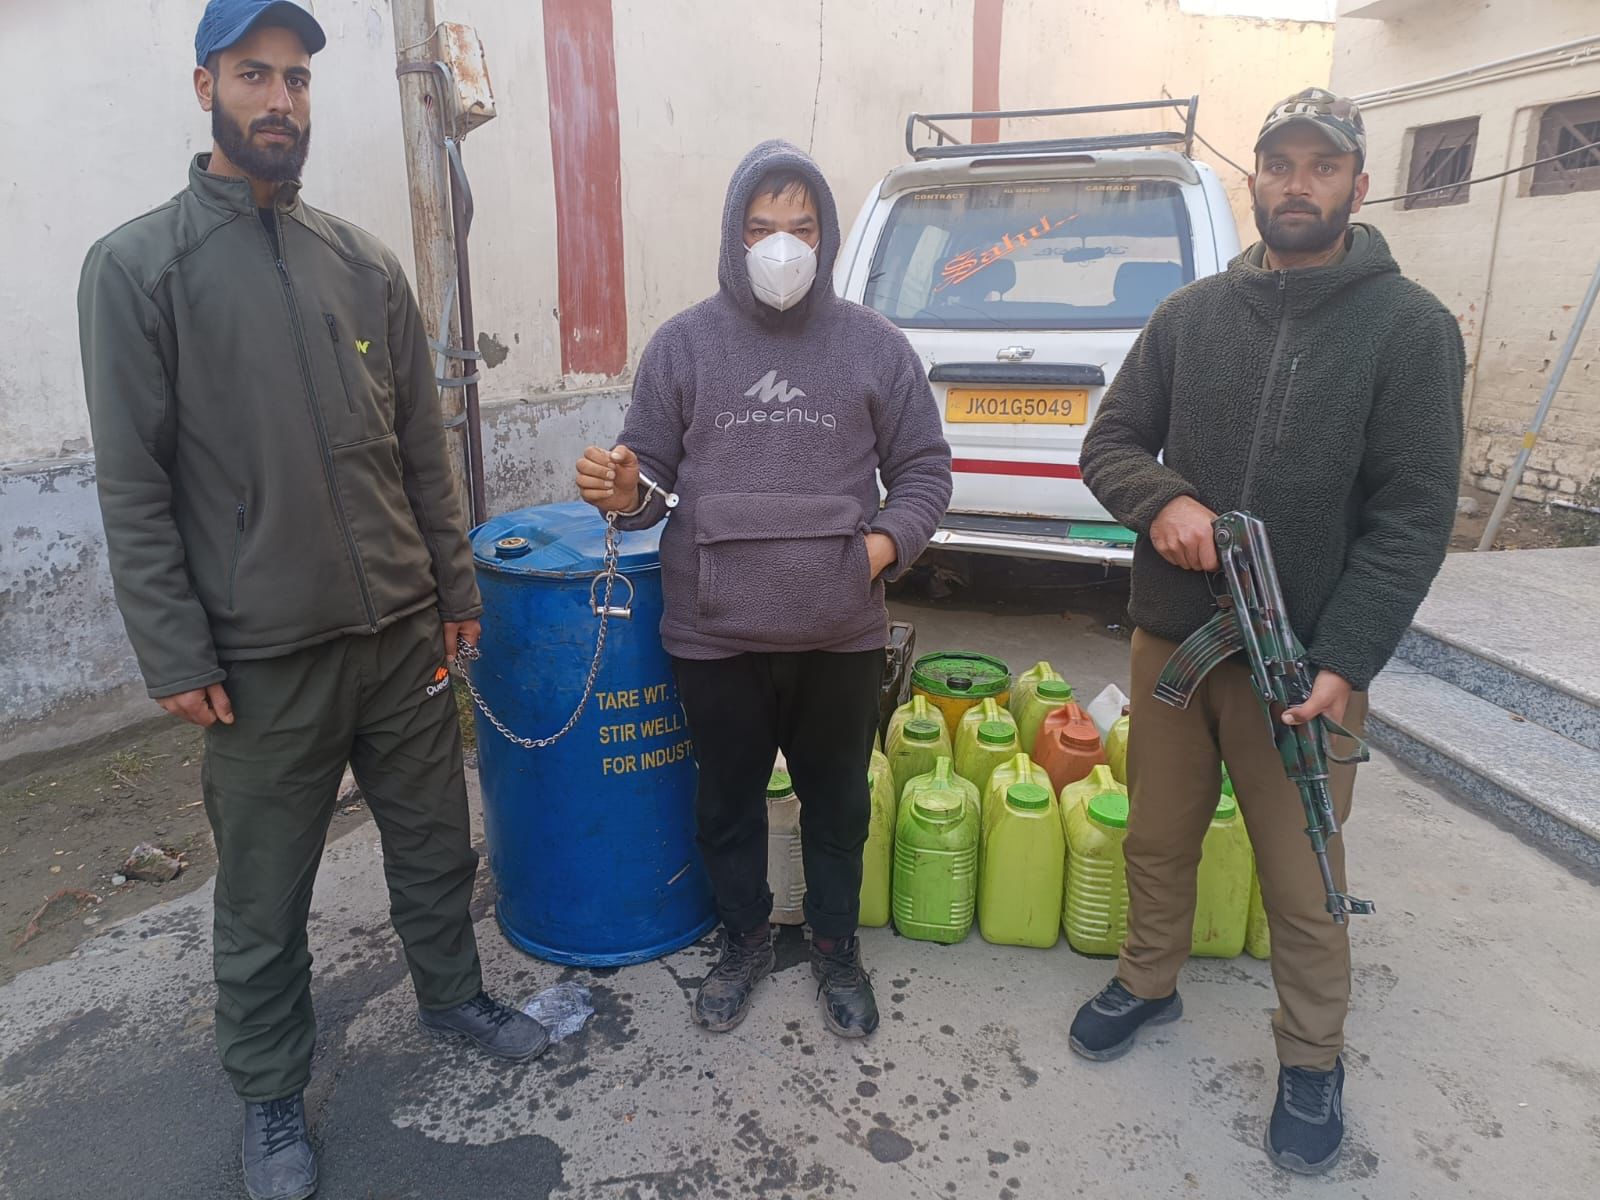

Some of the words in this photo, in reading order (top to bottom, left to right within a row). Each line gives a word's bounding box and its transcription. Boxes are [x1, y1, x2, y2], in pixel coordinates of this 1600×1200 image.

[914, 193, 965, 201] CONTRACT
[966, 397, 1072, 417] JK01G5049
[596, 690, 639, 710] TARE
[599, 723, 637, 745] STIR
[640, 714, 681, 738] WELL
[602, 754, 637, 776] FOR
